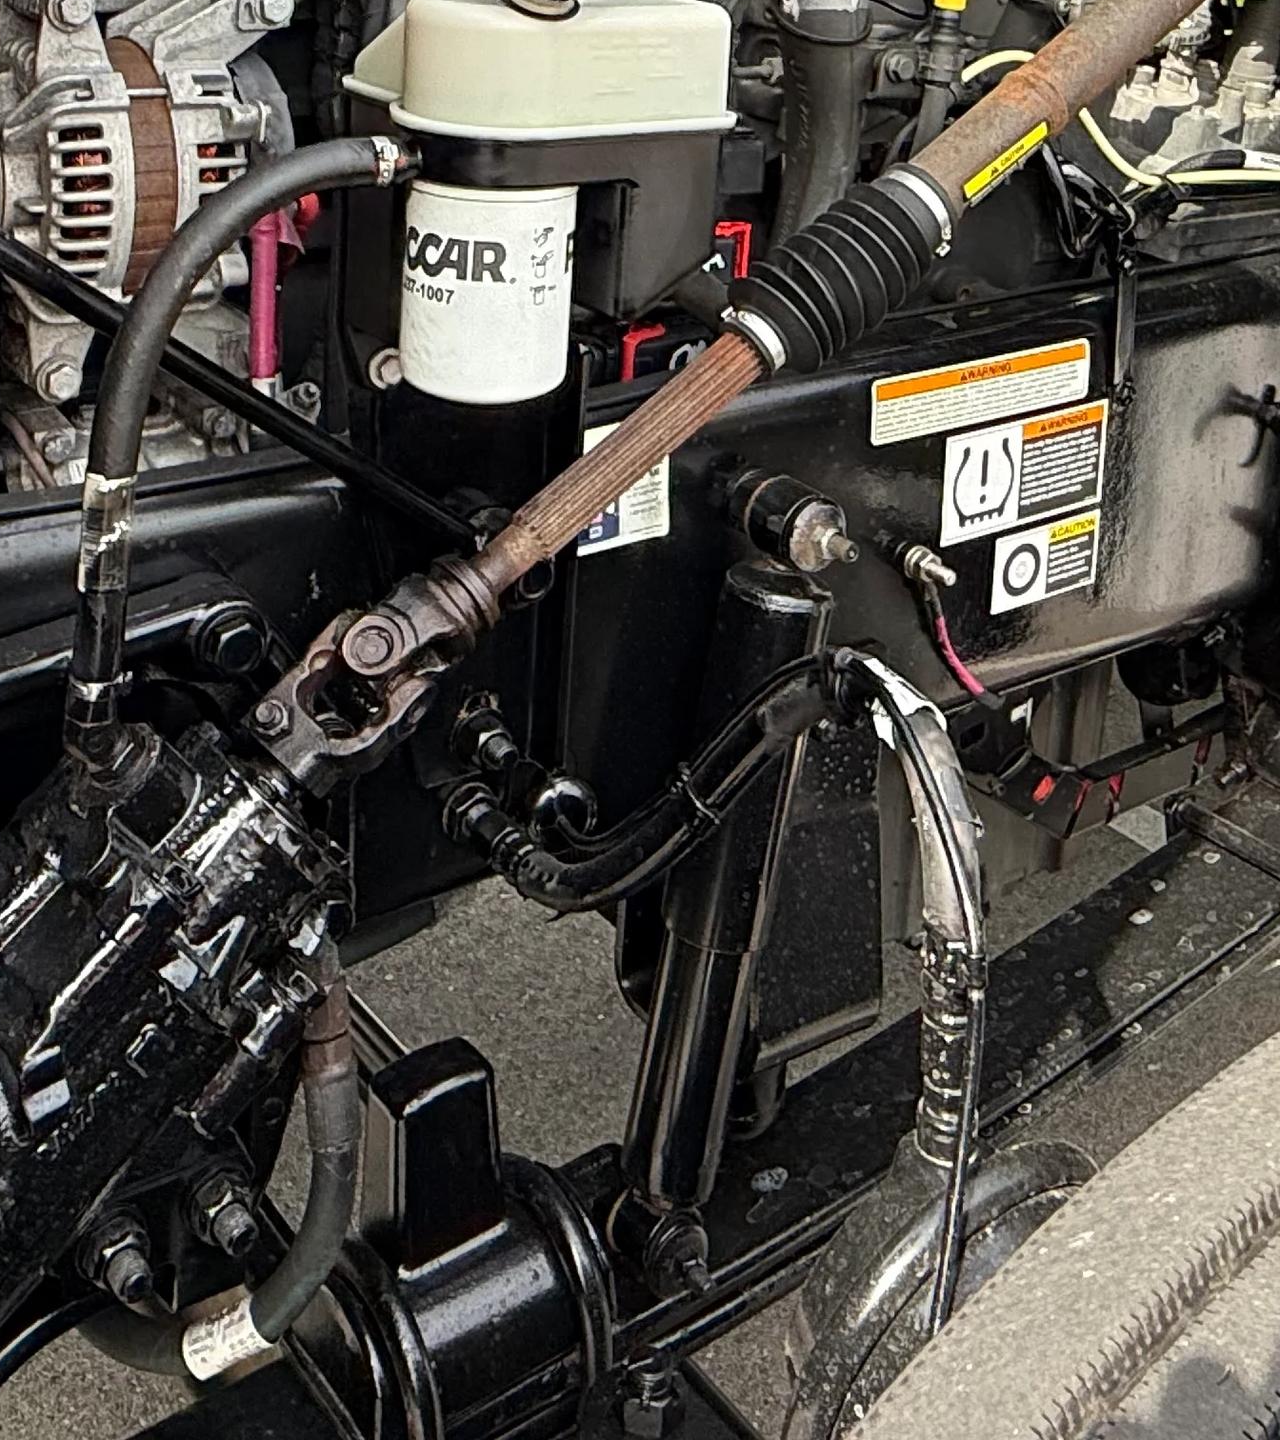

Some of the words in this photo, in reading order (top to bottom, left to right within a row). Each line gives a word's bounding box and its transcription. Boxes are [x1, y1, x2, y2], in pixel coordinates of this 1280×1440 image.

[966, 362, 1012, 382] WARNING
[1047, 411, 1089, 430] WARNING
[1057, 518, 1095, 537] CAUTION
